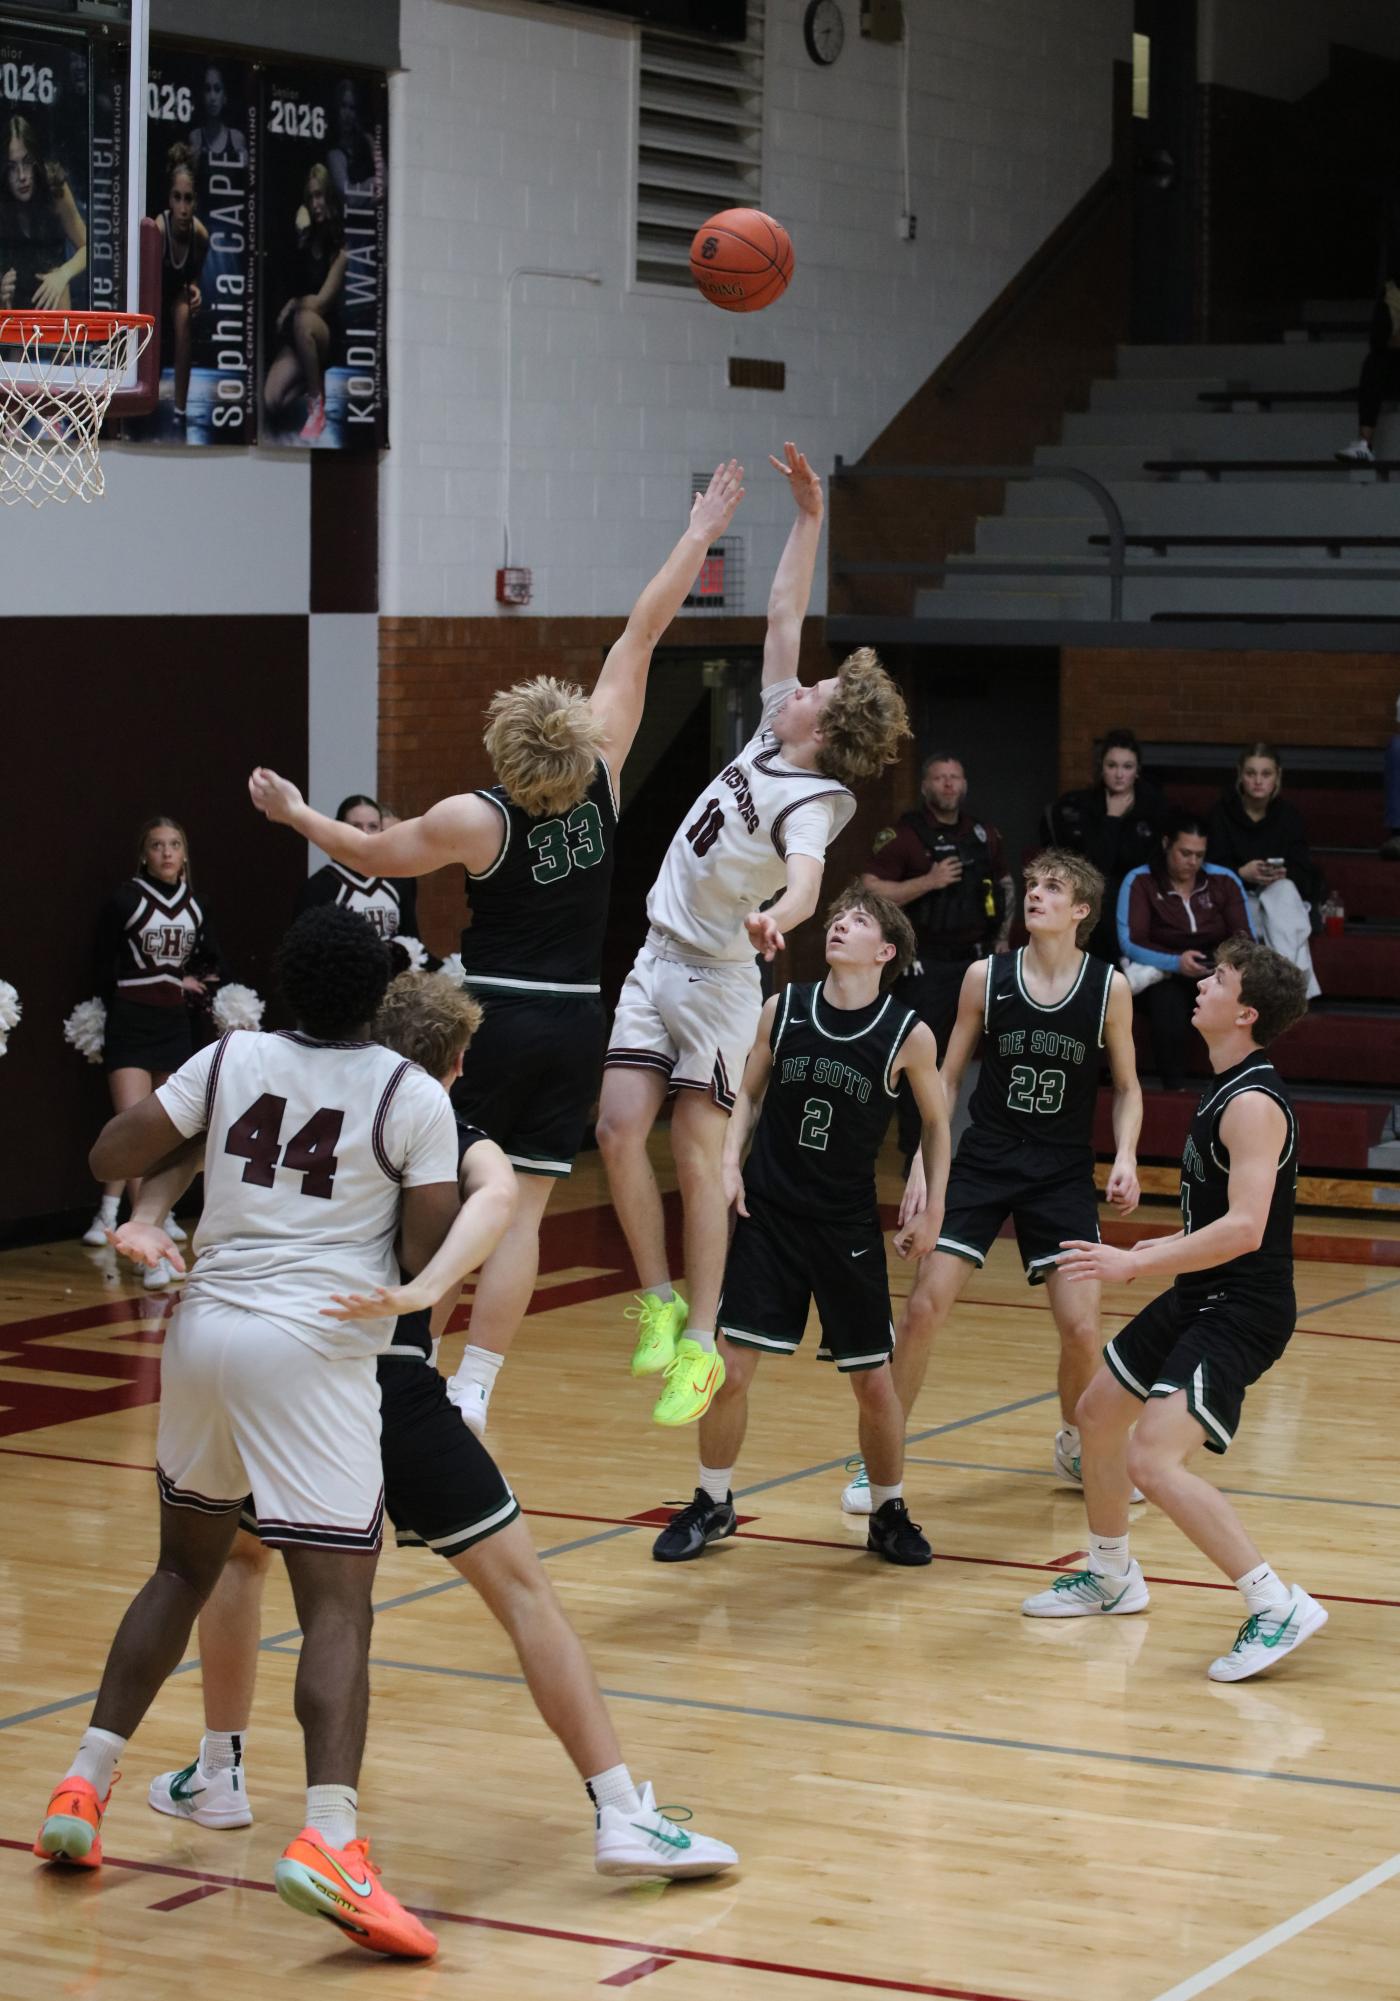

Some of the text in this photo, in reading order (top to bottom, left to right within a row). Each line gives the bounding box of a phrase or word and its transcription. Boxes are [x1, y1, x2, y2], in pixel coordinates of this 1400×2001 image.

[0, 62, 54, 105] 026
[147, 83, 191, 122] 026
[113, 84, 121, 167] WRESTLING
[269, 100, 326, 139] 2026
[208, 151, 247, 427] Sophia CAPE
[344, 182, 377, 422] KODI WAITE
[527, 802, 604, 885] 33
[685, 798, 725, 858] 10
[363, 906, 398, 936] HS
[1000, 1030, 1086, 1065] DE SOTO
[781, 1056, 872, 1104] DE SOTO
[1007, 1065, 1066, 1114] 23
[224, 1092, 345, 1199] 44
[798, 1097, 833, 1151] 2
